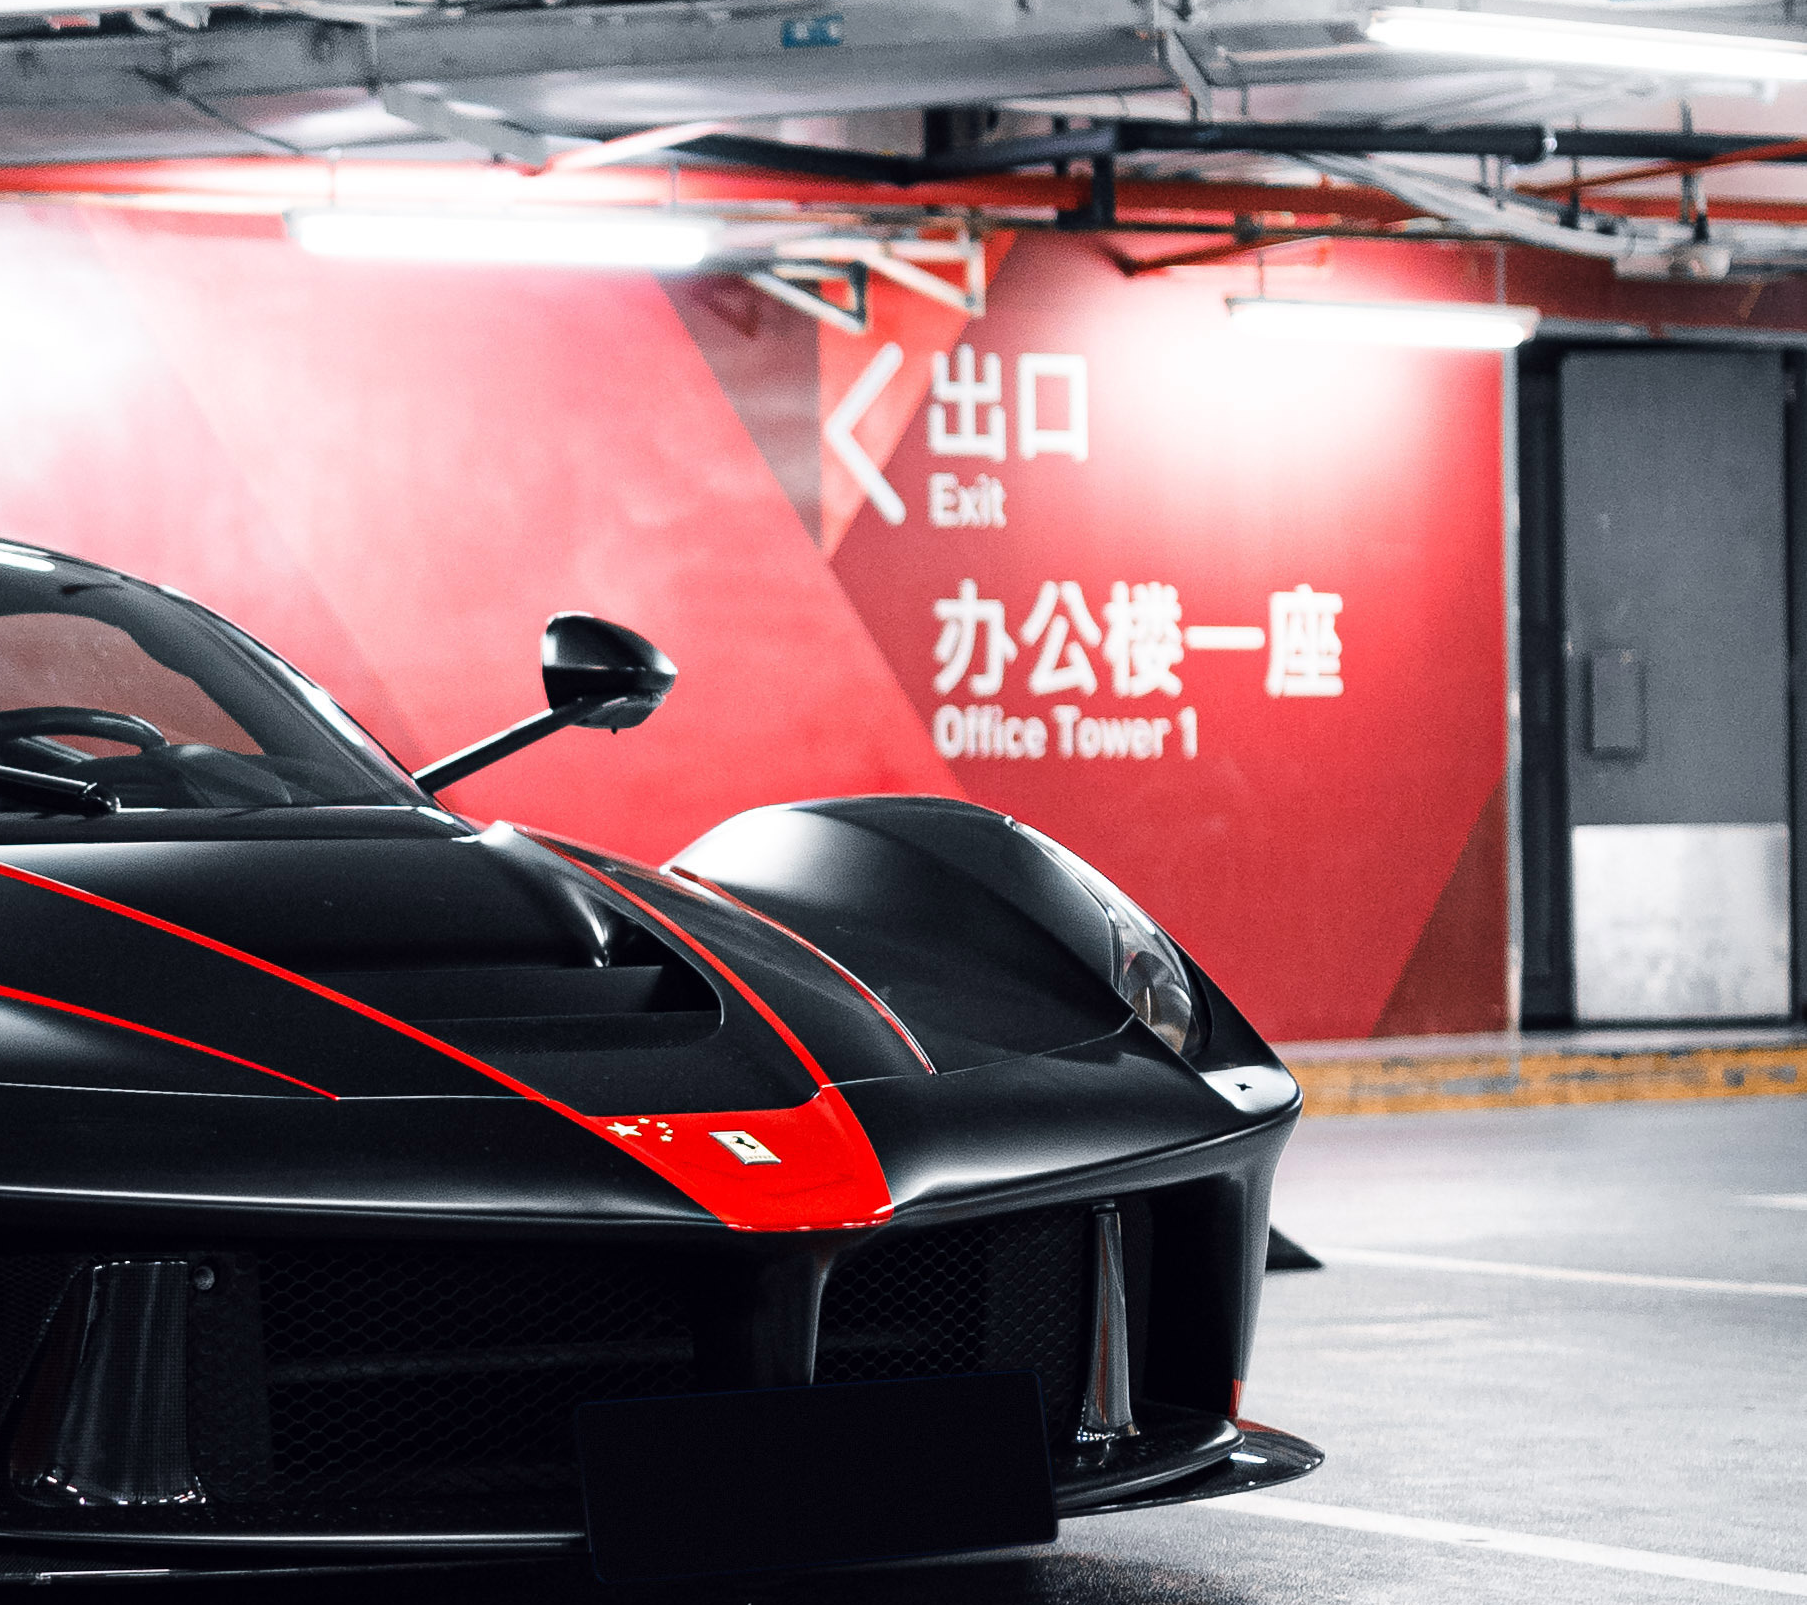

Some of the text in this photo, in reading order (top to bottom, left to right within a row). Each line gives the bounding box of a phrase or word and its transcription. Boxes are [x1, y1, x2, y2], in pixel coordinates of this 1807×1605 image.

[928, 344, 1090, 463] 出口
[929, 473, 1006, 528] Exit
[934, 579, 1345, 697] 办公楼一座
[934, 705, 1199, 760] Office Tower 1
